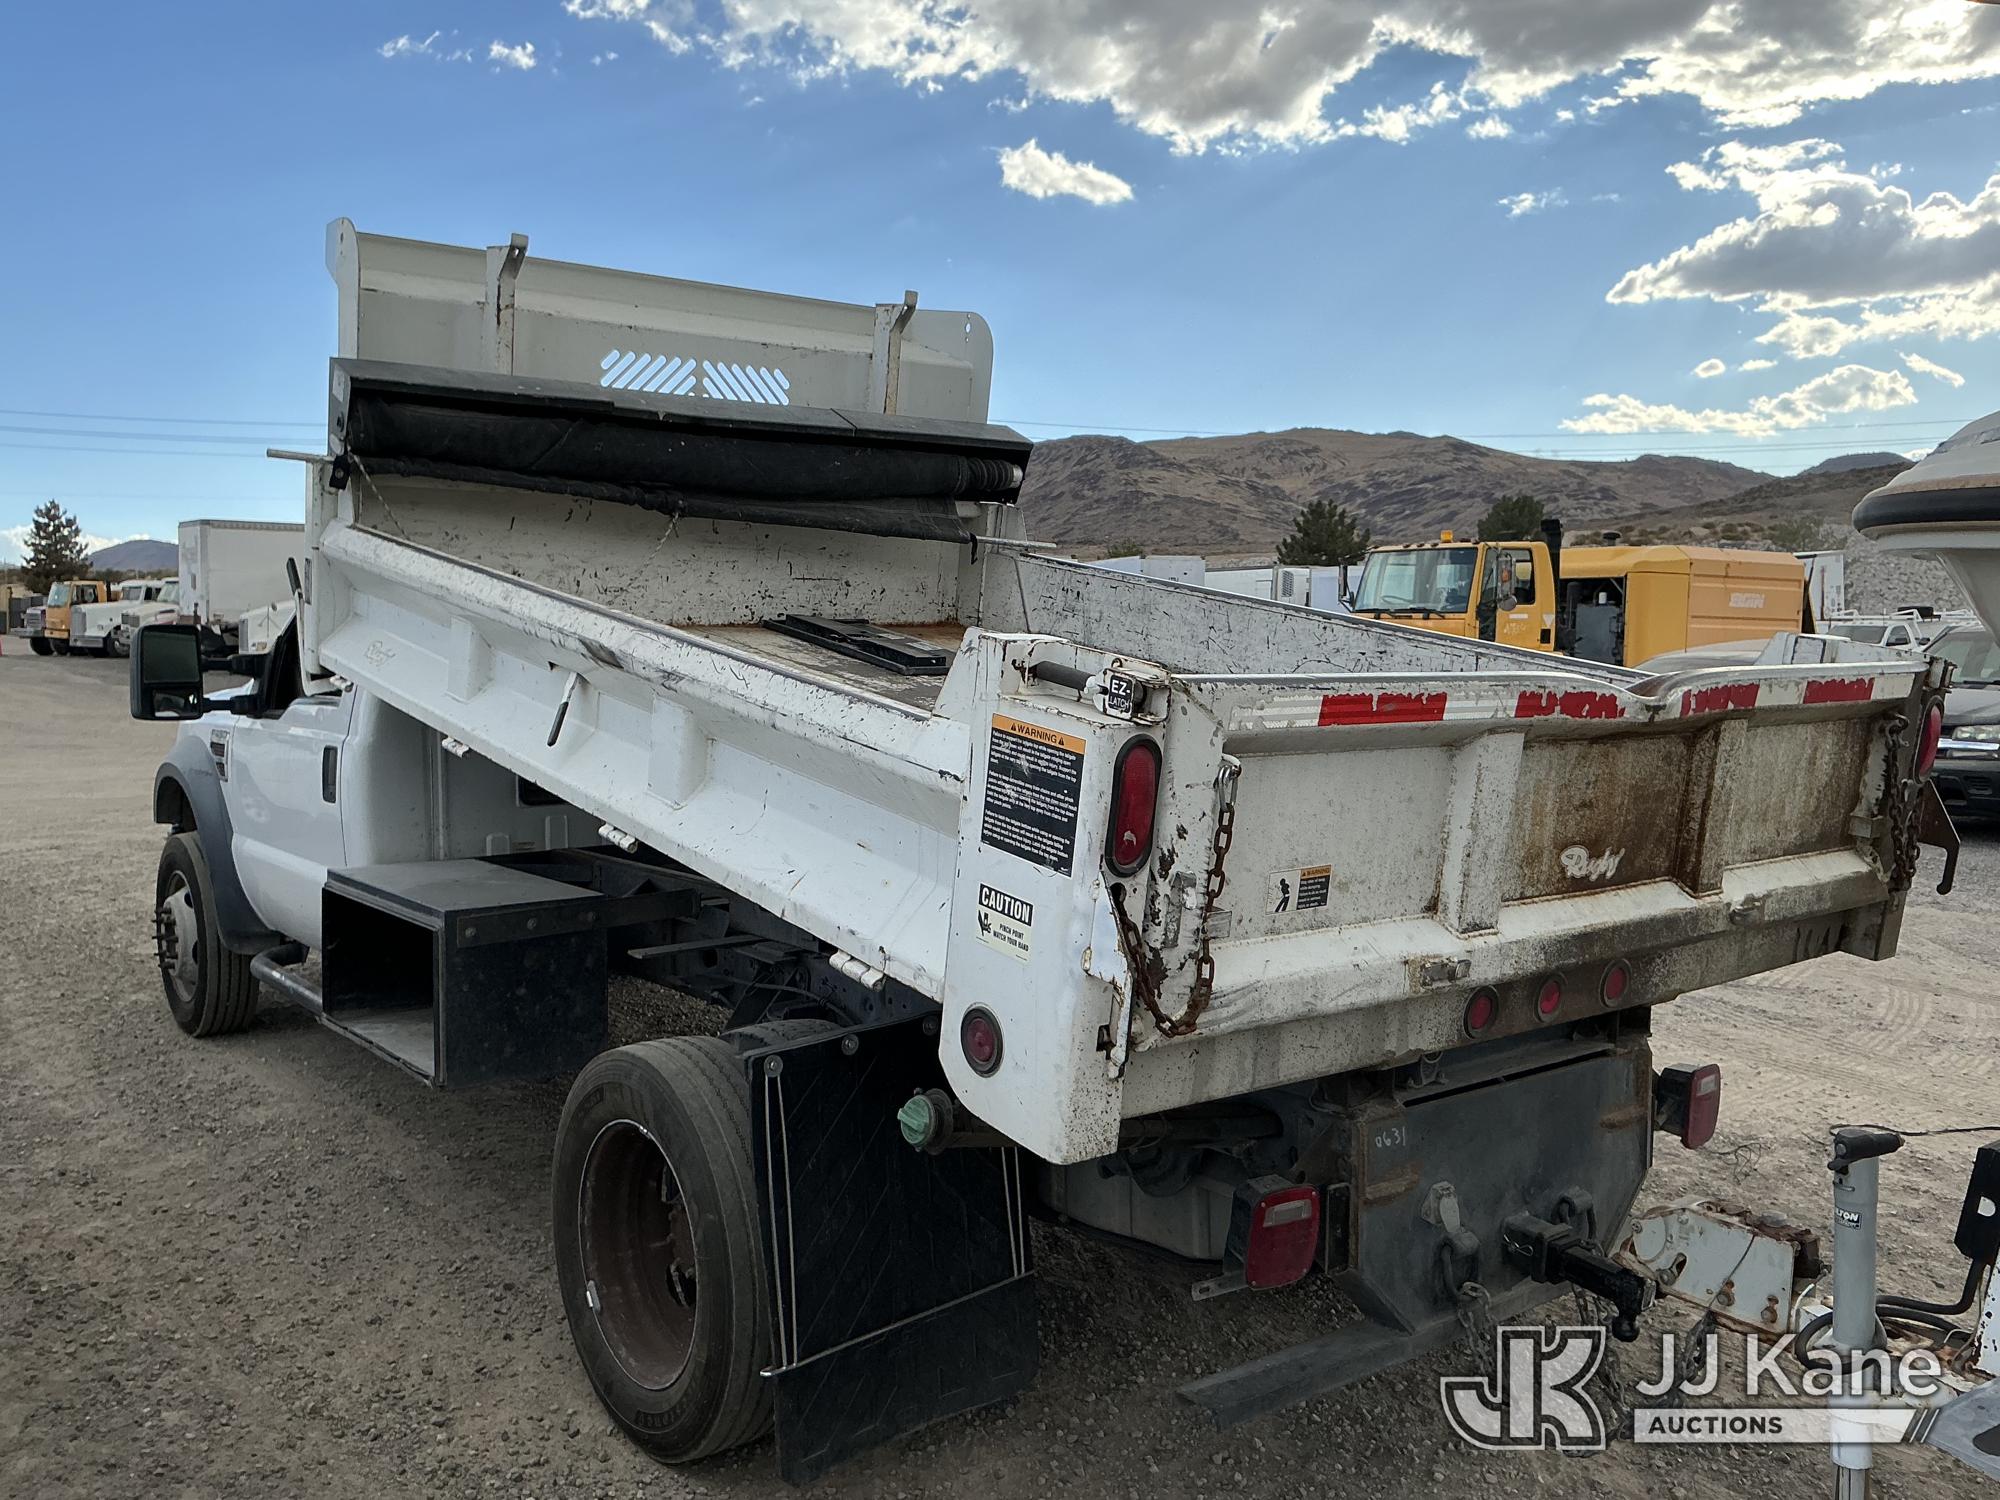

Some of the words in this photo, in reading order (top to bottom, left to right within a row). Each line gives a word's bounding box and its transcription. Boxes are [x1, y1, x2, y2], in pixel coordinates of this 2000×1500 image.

[1111, 680, 1131, 696] EZ-
[1109, 696, 1130, 709] LATCH
[1017, 723, 1057, 744] WARNING
[1306, 867, 1330, 876] WARNING
[1560, 844, 1625, 882] Rugby
[981, 887, 1030, 923] CAUTION
[993, 930, 1006, 942] WATCH
[1007, 936, 1017, 947] YOUR
[1018, 941, 1029, 952] HAND
[999, 923, 1012, 935] PINCH
[1012, 928, 1024, 940] POINT
